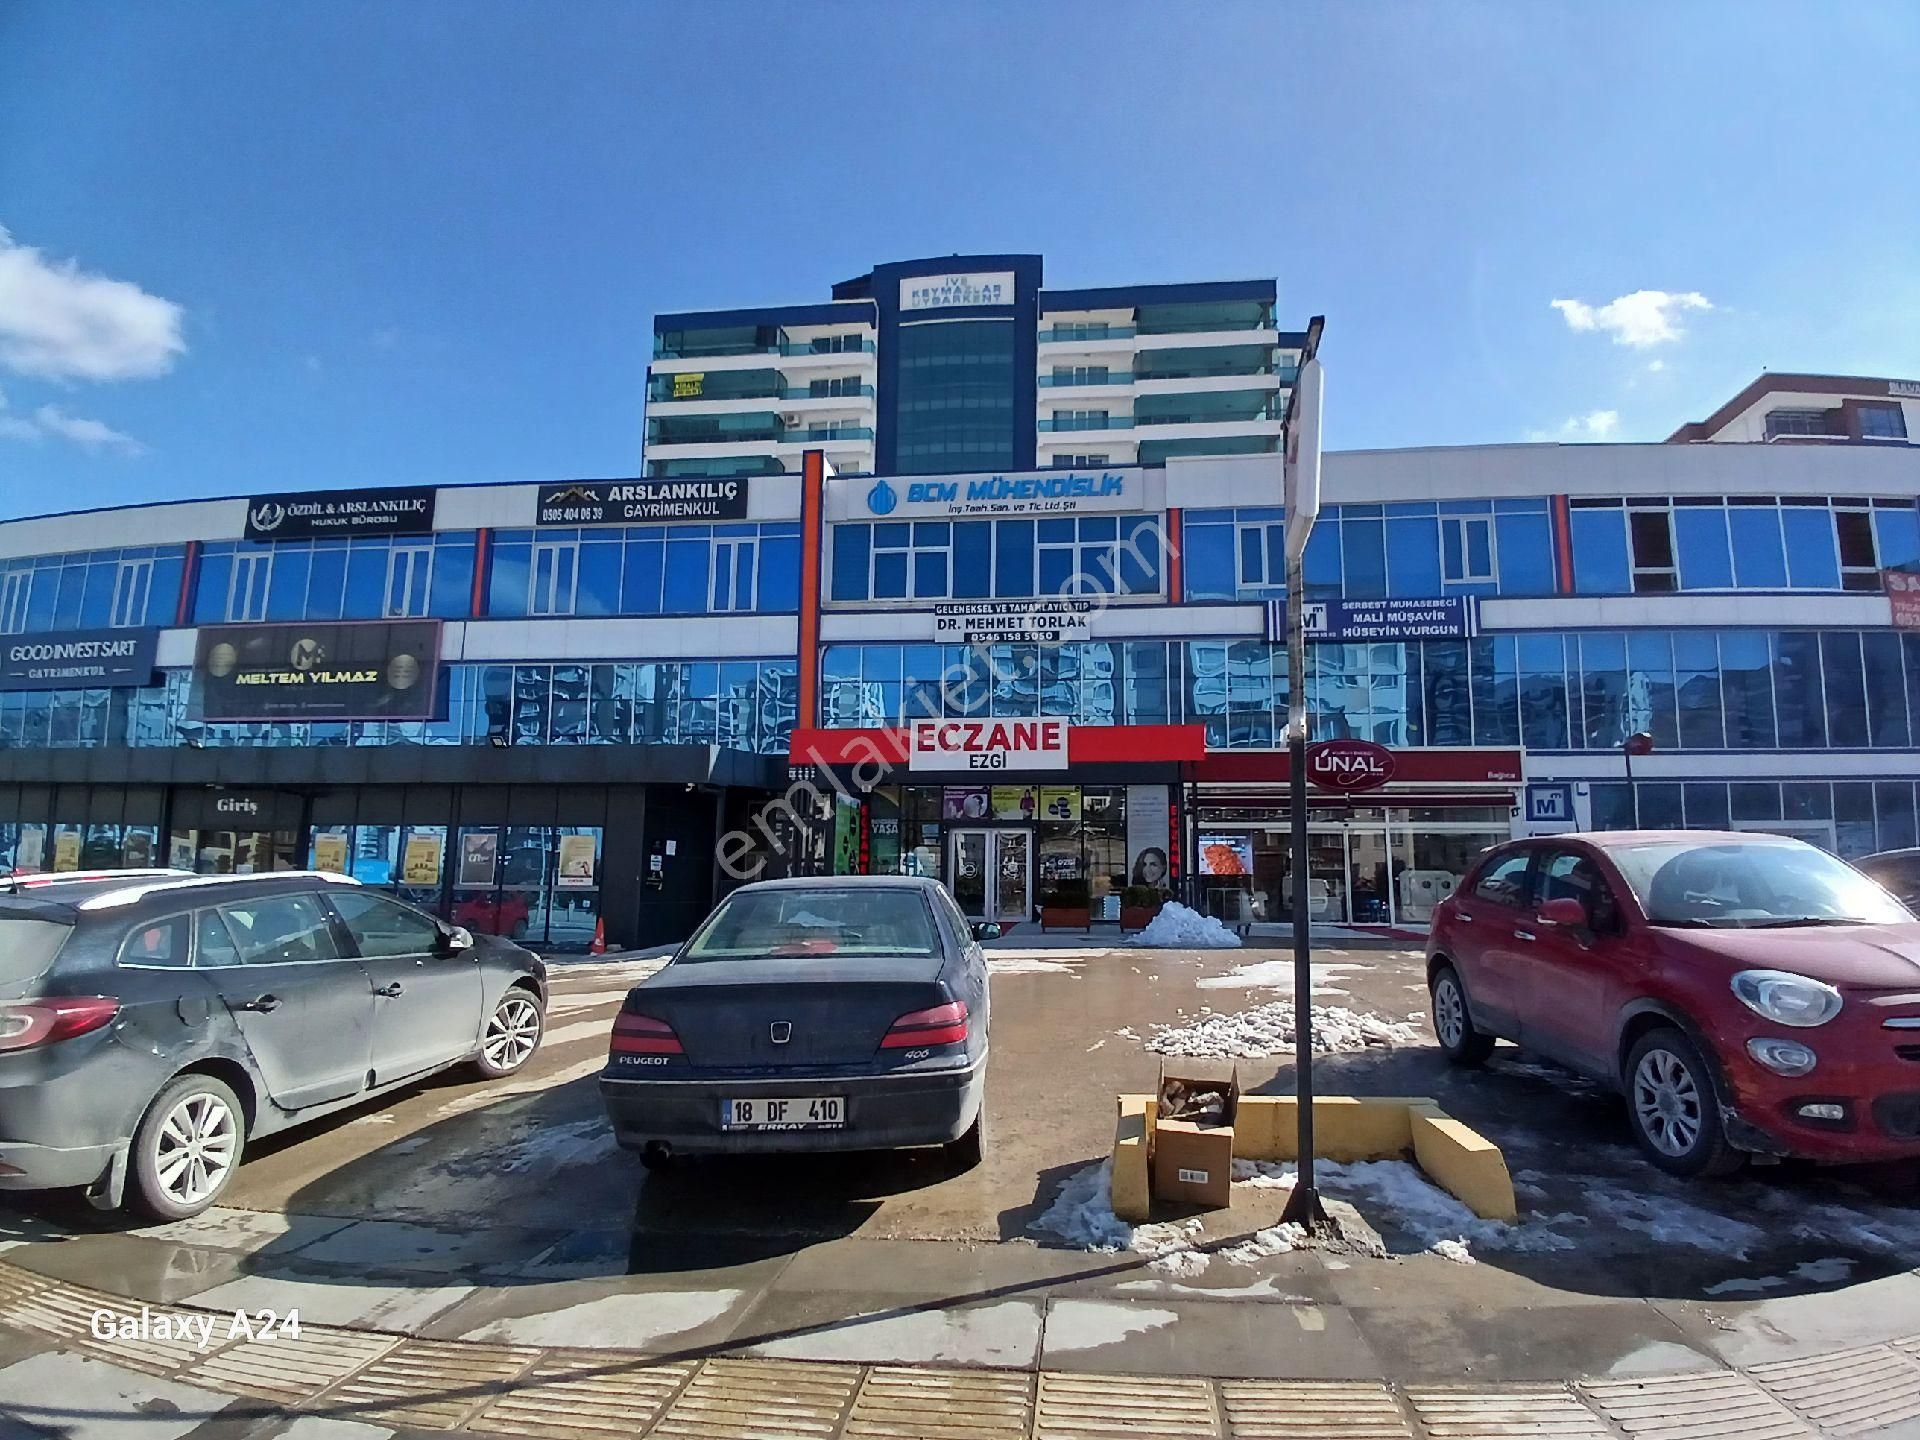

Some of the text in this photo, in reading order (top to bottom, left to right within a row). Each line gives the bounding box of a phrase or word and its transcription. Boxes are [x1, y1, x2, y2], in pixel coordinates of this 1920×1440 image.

[608, 482, 738, 501] ARSLANKILIÇ
[907, 473, 1123, 502] BCM MÜHENDİSLİK
[287, 499, 427, 516] ÖZDİL & ARSLANKILIÇ
[563, 508, 579, 520] 404
[624, 501, 720, 518] GAYRİMENKUL
[311, 515, 398, 526] HUKUK BÜROSU
[936, 602, 1089, 614] GELENEKSEL VE TAMAMLAYICI TIP
[1342, 598, 1457, 610] SERBEST MUHASEBECİ
[937, 616, 1087, 630] DR. MEHMET TORLAK
[1353, 609, 1446, 623] MALİ MÜŞAVİR
[1003, 632, 1021, 640] 158
[1024, 631, 1053, 640] 5050
[1342, 625, 1399, 637] HÜSEYİN
[1403, 624, 1459, 636] VURGUN
[235, 671, 378, 685] MELTEM YILMAZ
[917, 722, 1061, 752] ECZANE
[969, 750, 1007, 769] EZGİ
[217, 798, 257, 815] Giriş
[619, 1056, 670, 1065] PEUGEOT
[905, 1050, 930, 1059] 406
[735, 1099, 838, 1121] 18 DF 410
[757, 1123, 807, 1131] ERKAY
